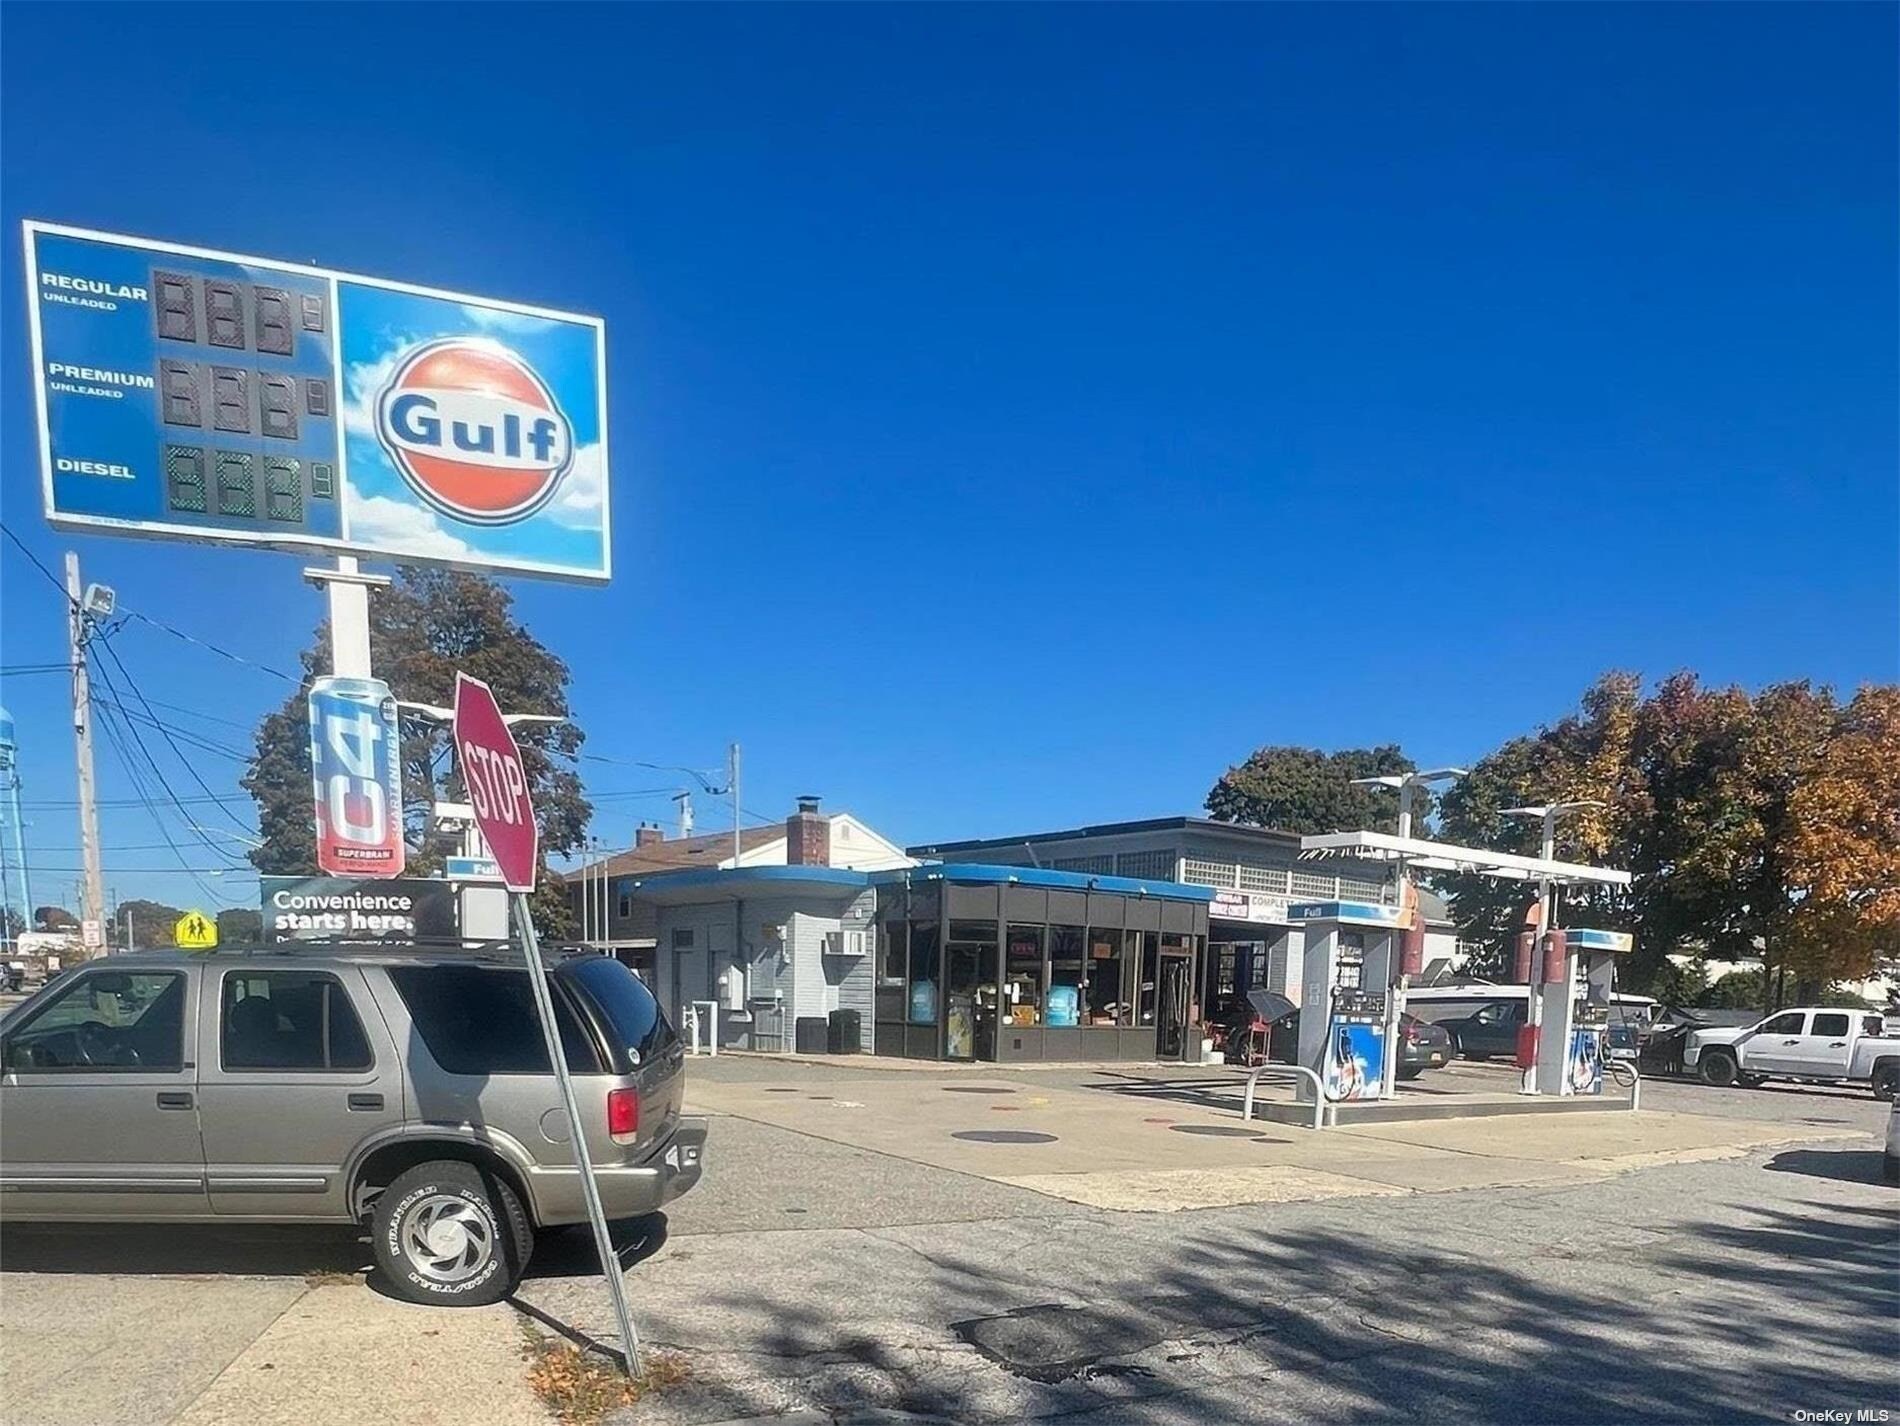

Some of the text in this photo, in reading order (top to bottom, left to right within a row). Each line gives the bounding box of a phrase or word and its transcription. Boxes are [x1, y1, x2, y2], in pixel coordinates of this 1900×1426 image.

[42, 272, 148, 301] REGULAR
[43, 292, 118, 311] UNLEADED
[49, 362, 155, 389] PREMIUM
[50, 381, 124, 398] UNLEADED
[390, 394, 557, 462] Gulf
[57, 458, 136, 479] DIESEL
[327, 710, 388, 847] C4
[464, 740, 524, 826] STOP
[337, 849, 391, 858] SUPERBRAIN
[273, 890, 412, 910] Convenience
[275, 911, 414, 930] starts here.
[1303, 907, 1322, 918] Full
